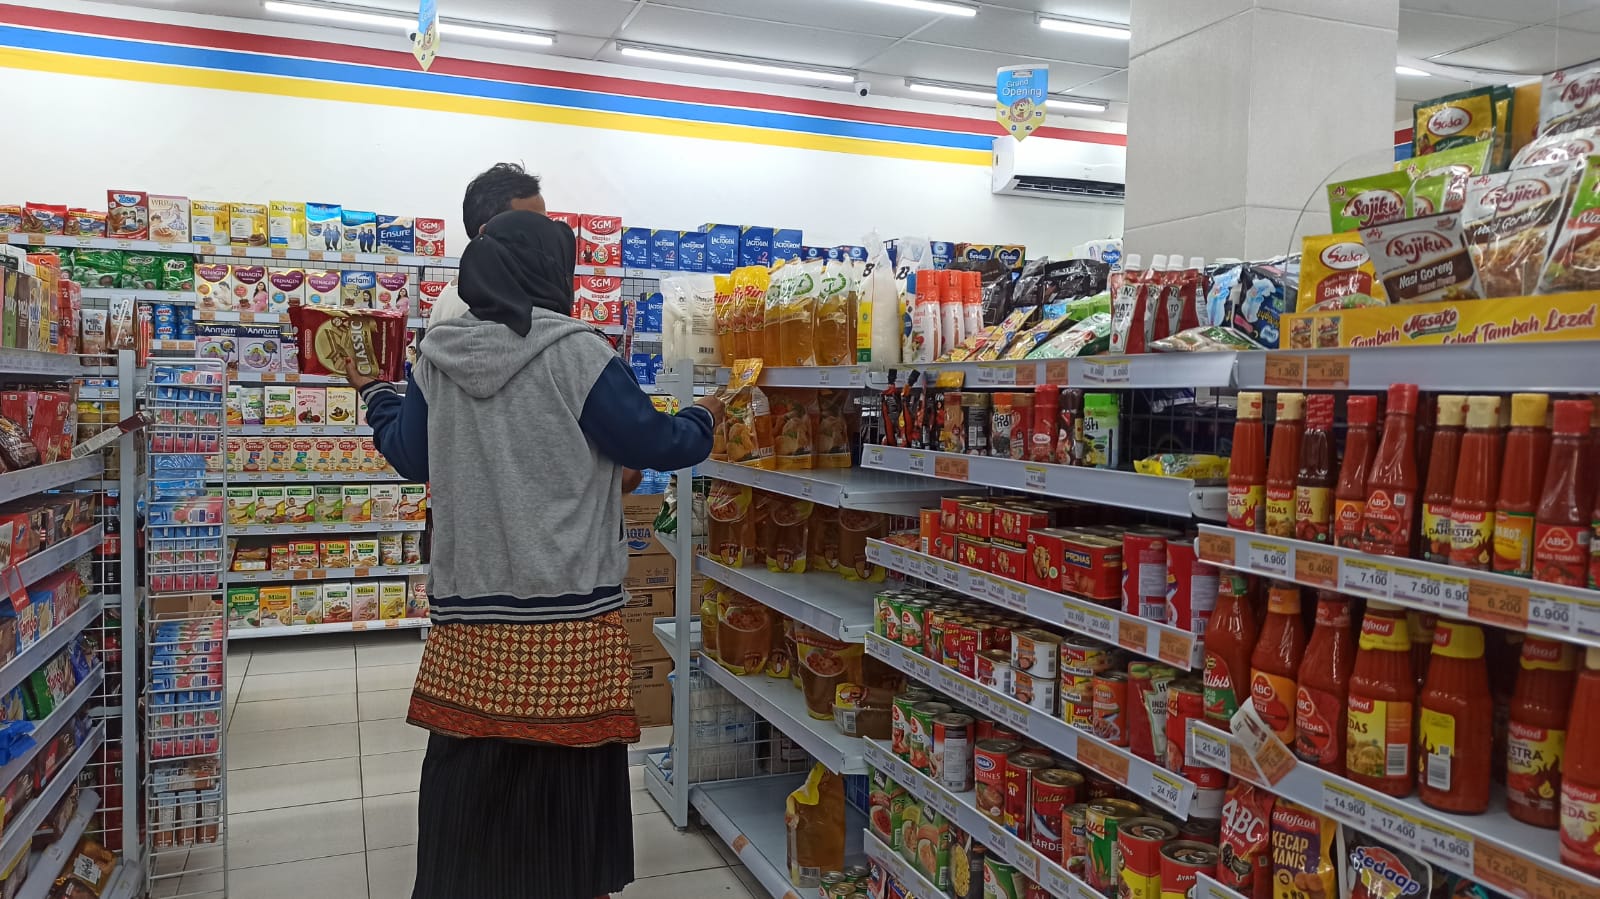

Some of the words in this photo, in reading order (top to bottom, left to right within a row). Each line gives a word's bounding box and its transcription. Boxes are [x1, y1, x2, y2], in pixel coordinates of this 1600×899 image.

[1007, 79, 1029, 88] Grand
[1002, 88, 1042, 98] Opening
[1433, 116, 1463, 131] Sasa
[1351, 196, 1399, 227] Sajiku
[421, 222, 438, 230] SGM
[591, 220, 612, 230] SGM
[380, 230, 411, 239] Ensure
[711, 236, 735, 245] LACTOGEN
[1327, 245, 1363, 263] Sasa
[1394, 235, 1446, 265] Sajiku
[1400, 273, 1418, 289] Nasi
[1420, 261, 1454, 281] Goreng
[591, 278, 611, 288] SGM
[204, 326, 237, 334] Anmum
[247, 327, 278, 335] Anmum
[1351, 326, 1400, 347] Tambah
[1403, 308, 1457, 333] Masako
[1481, 316, 1539, 344] Tambah
[1543, 303, 1596, 333] Lezat
[350, 320, 372, 375] CLASSIC
[1371, 498, 1387, 507] ABC
[1342, 510, 1358, 518] ABC
[625, 527, 651, 538] AQUA
[1546, 536, 1569, 547] ABC
[1264, 554, 1287, 566] 6.900
[1360, 572, 1388, 586] 7.100
[1411, 581, 1441, 596] 7.500
[1488, 600, 1521, 614] 6.200
[1532, 606, 1570, 623] 6.900
[1253, 683, 1271, 696] ABC
[1202, 742, 1226, 758] 21.500
[1157, 785, 1177, 801] 24.700
[1335, 797, 1366, 817] 14.900
[1222, 798, 1266, 843] ABC
[1381, 817, 1416, 839] 17.400
[1272, 830, 1309, 852] KECAP
[1432, 837, 1470, 858] 14.900
[1485, 856, 1528, 883] 12.000
